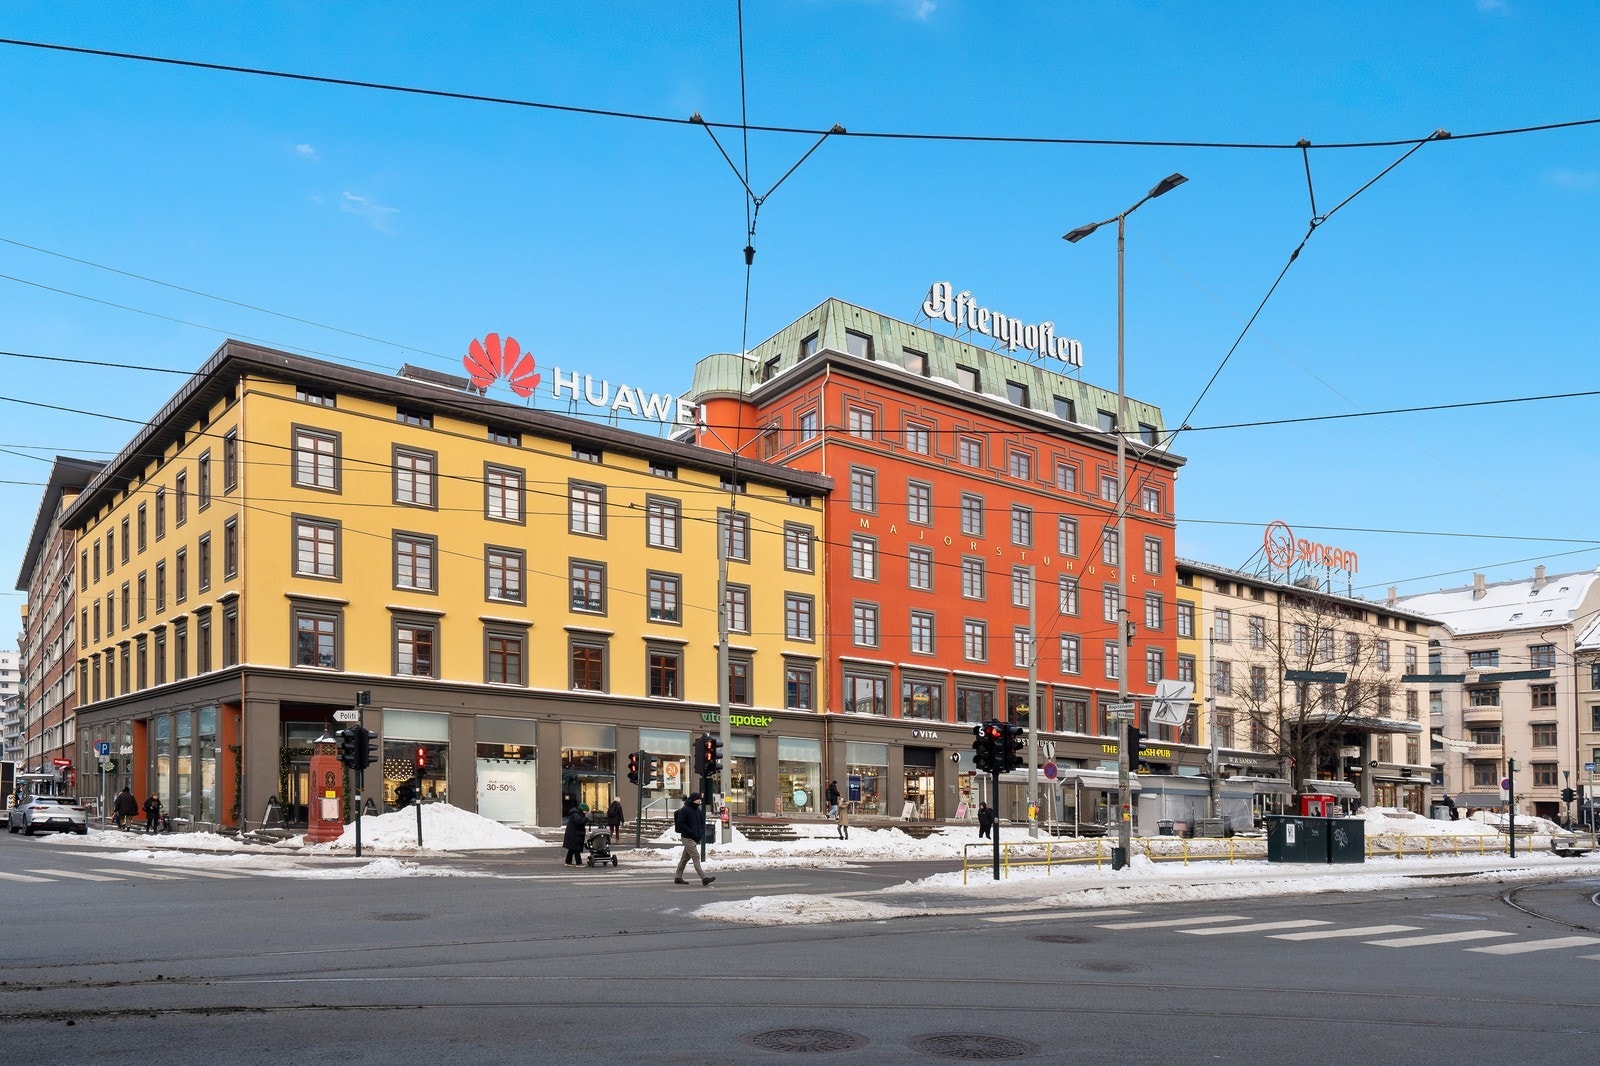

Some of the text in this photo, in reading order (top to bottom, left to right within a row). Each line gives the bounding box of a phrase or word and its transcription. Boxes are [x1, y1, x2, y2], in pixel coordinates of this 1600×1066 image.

[552, 367, 707, 432] HUAWEI
[860, 518, 1157, 587] MAJORSTUHUSET
[1297, 538, 1358, 573] SYNSAM
[340, 712, 357, 720] Politi
[920, 730, 938, 739] VITA
[102, 744, 108, 754] P
[1102, 744, 1118, 754] THE
[1156, 748, 1171, 758] PUB
[486, 783, 517, 792] 30-50%
